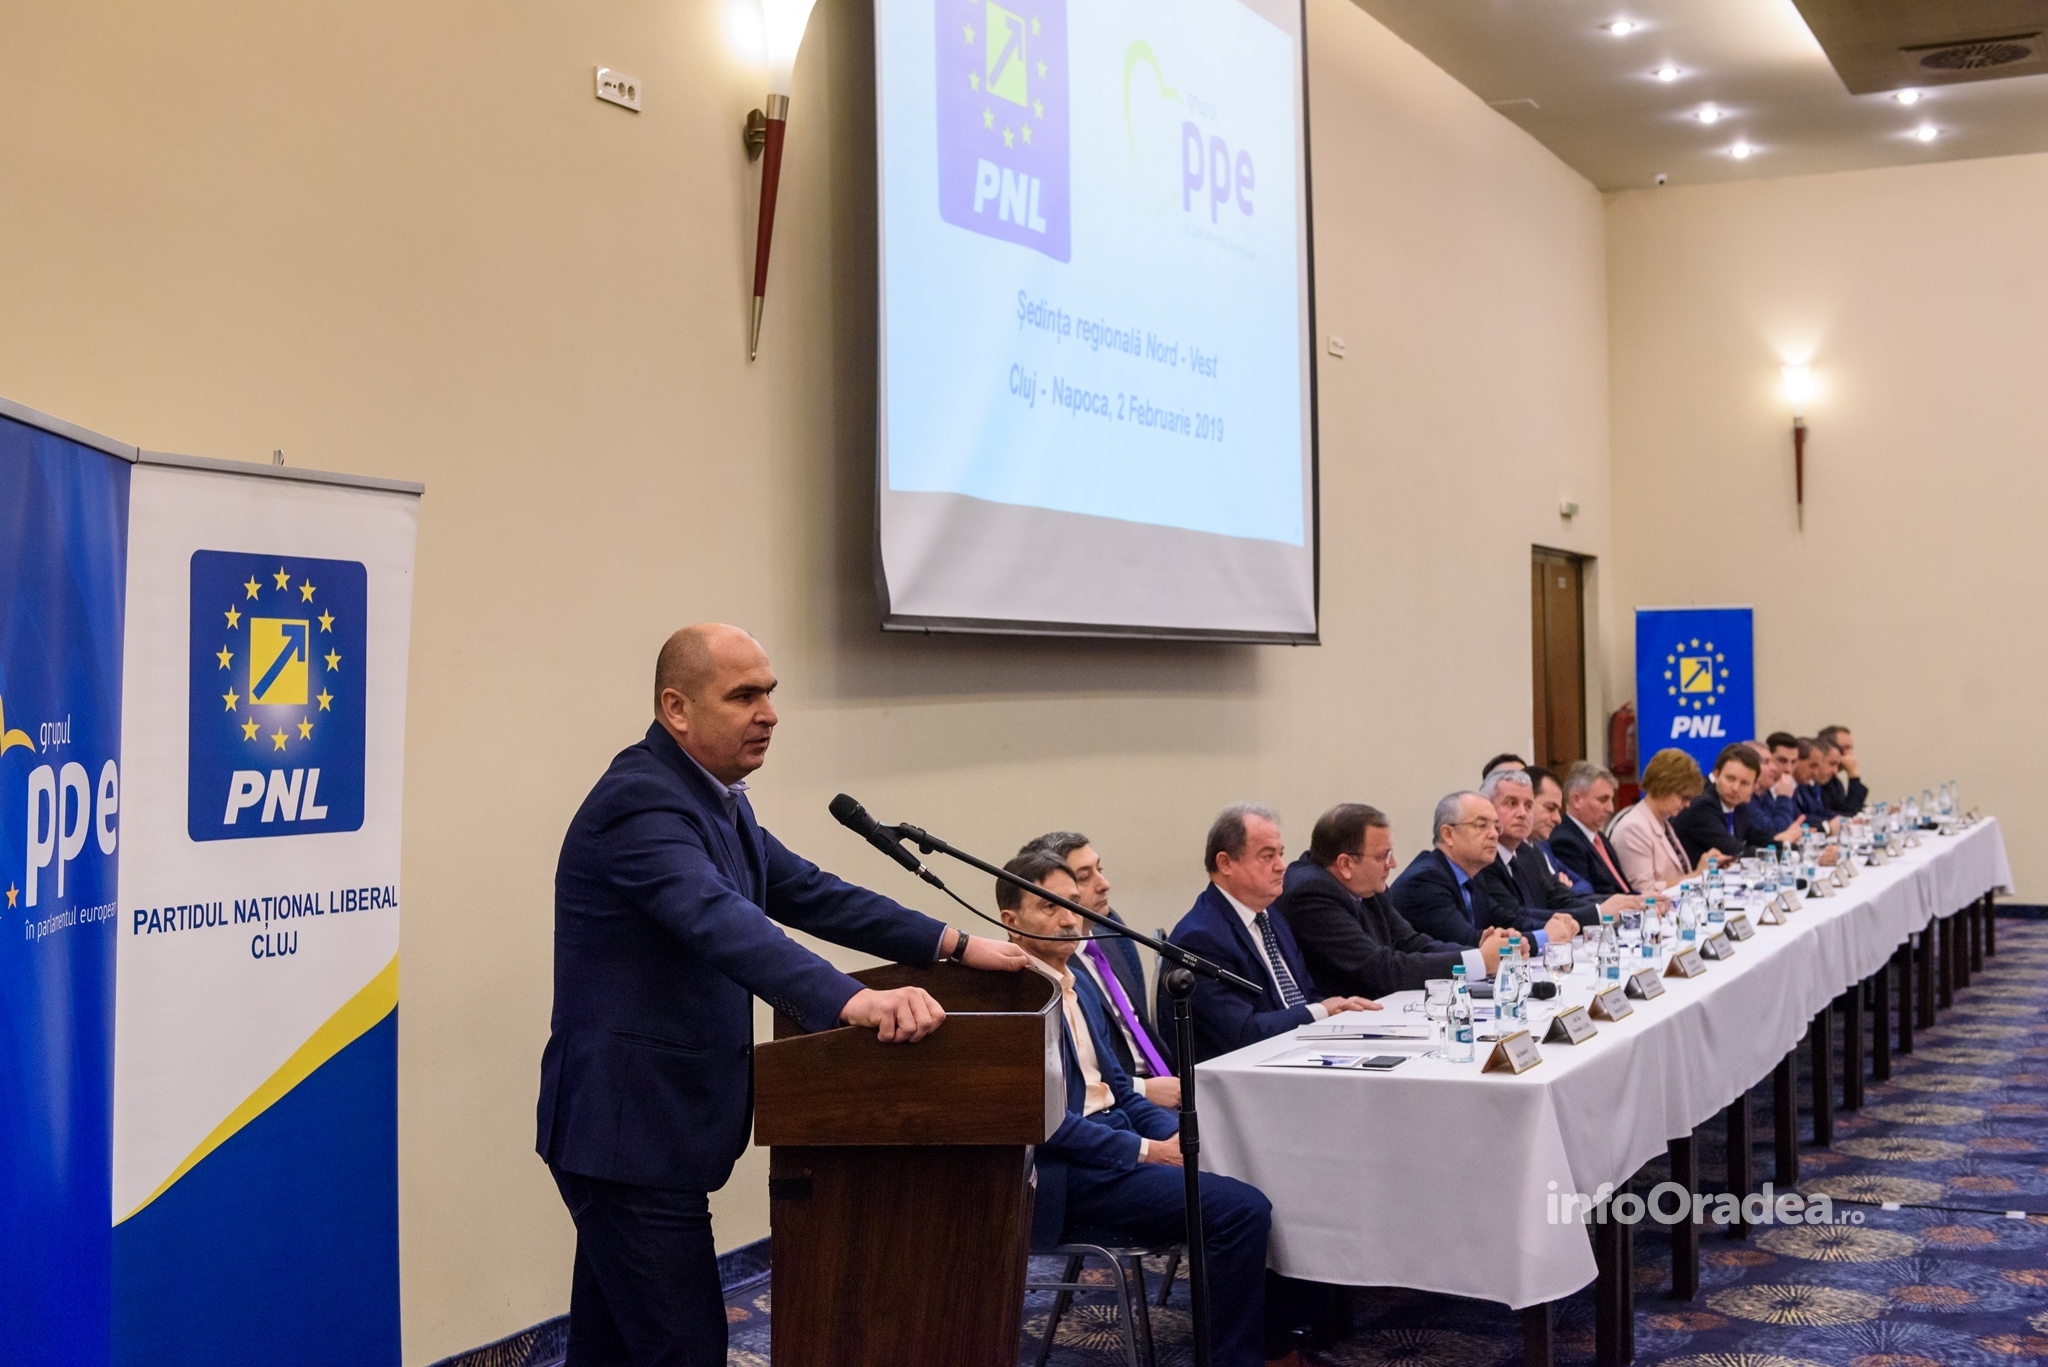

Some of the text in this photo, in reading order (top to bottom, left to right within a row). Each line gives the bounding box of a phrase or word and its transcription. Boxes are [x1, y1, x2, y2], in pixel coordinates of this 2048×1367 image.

[973, 158, 1046, 234] PNL
[1182, 121, 1256, 225] ppe
[1016, 289, 1072, 344] Ședința
[1075, 316, 1142, 357] regională
[1145, 332, 1179, 368] Nord
[1189, 345, 1219, 379] Vest
[1009, 362, 1037, 409] Cluj
[1051, 375, 1113, 423] Napoca,
[1117, 392, 1126, 421] 2
[1128, 394, 1192, 437] Februarie
[1194, 412, 1225, 443] 2019
[40, 713, 71, 754] grupul
[1670, 714, 1726, 739] PNL
[223, 767, 328, 825] PNL
[25, 758, 119, 908] ppe
[25, 918, 35, 941] în
[36, 905, 77, 943] parlamentul
[133, 885, 398, 936] PARTIDUL NAȚIONAL LIBERAL
[251, 930, 298, 960] CLUJ
